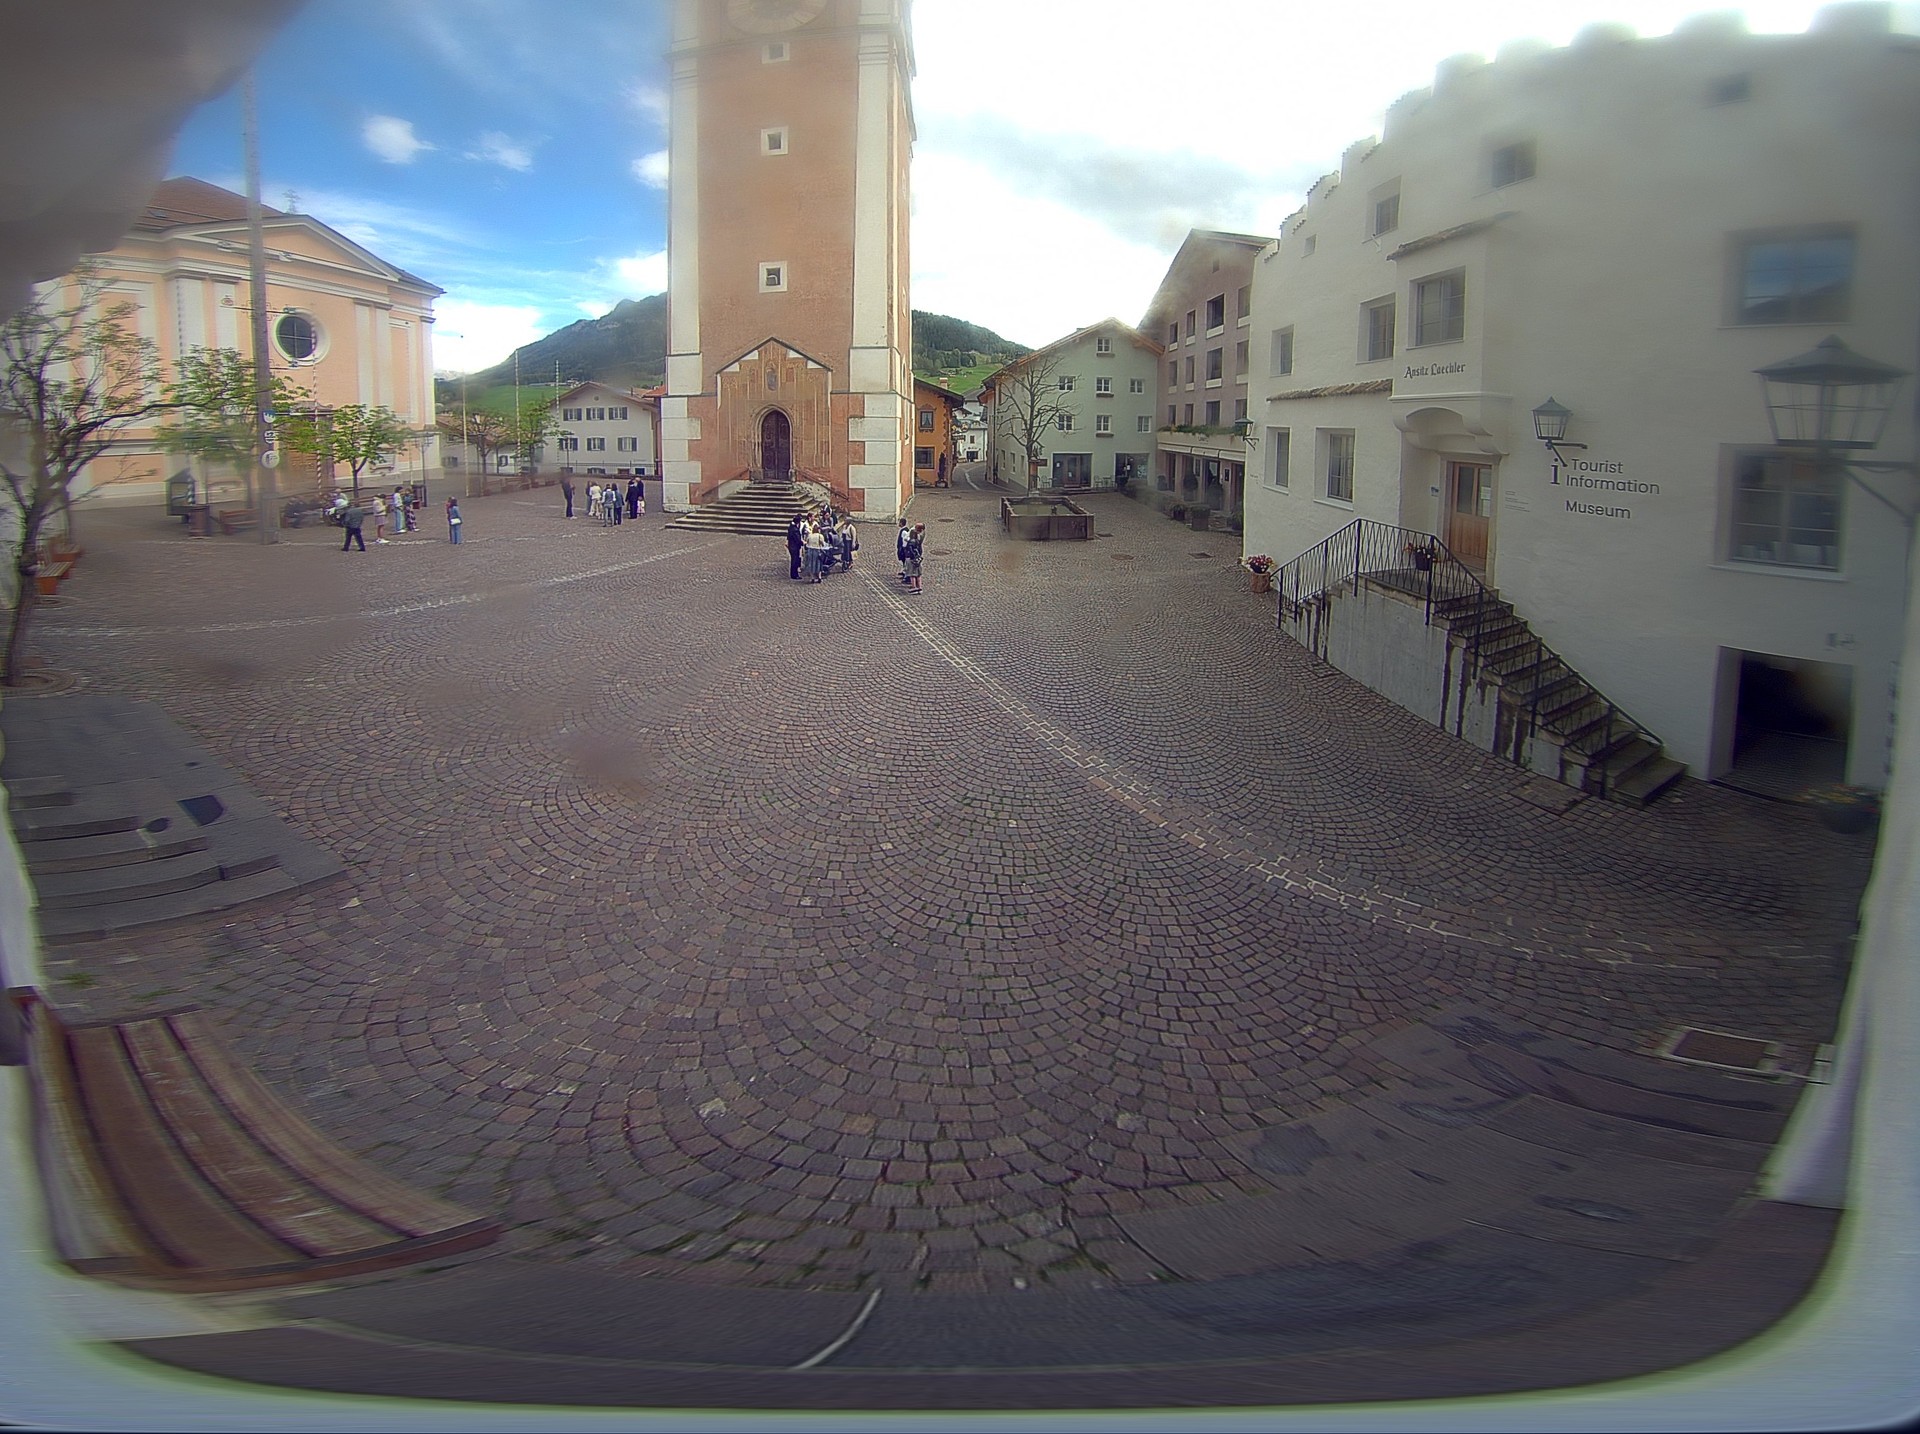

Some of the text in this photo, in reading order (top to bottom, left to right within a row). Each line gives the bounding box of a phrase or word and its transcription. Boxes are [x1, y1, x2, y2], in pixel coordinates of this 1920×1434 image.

[1571, 458, 1624, 474] Tourist
[1566, 475, 1660, 495] Information
[1566, 500, 1631, 519] Museum
